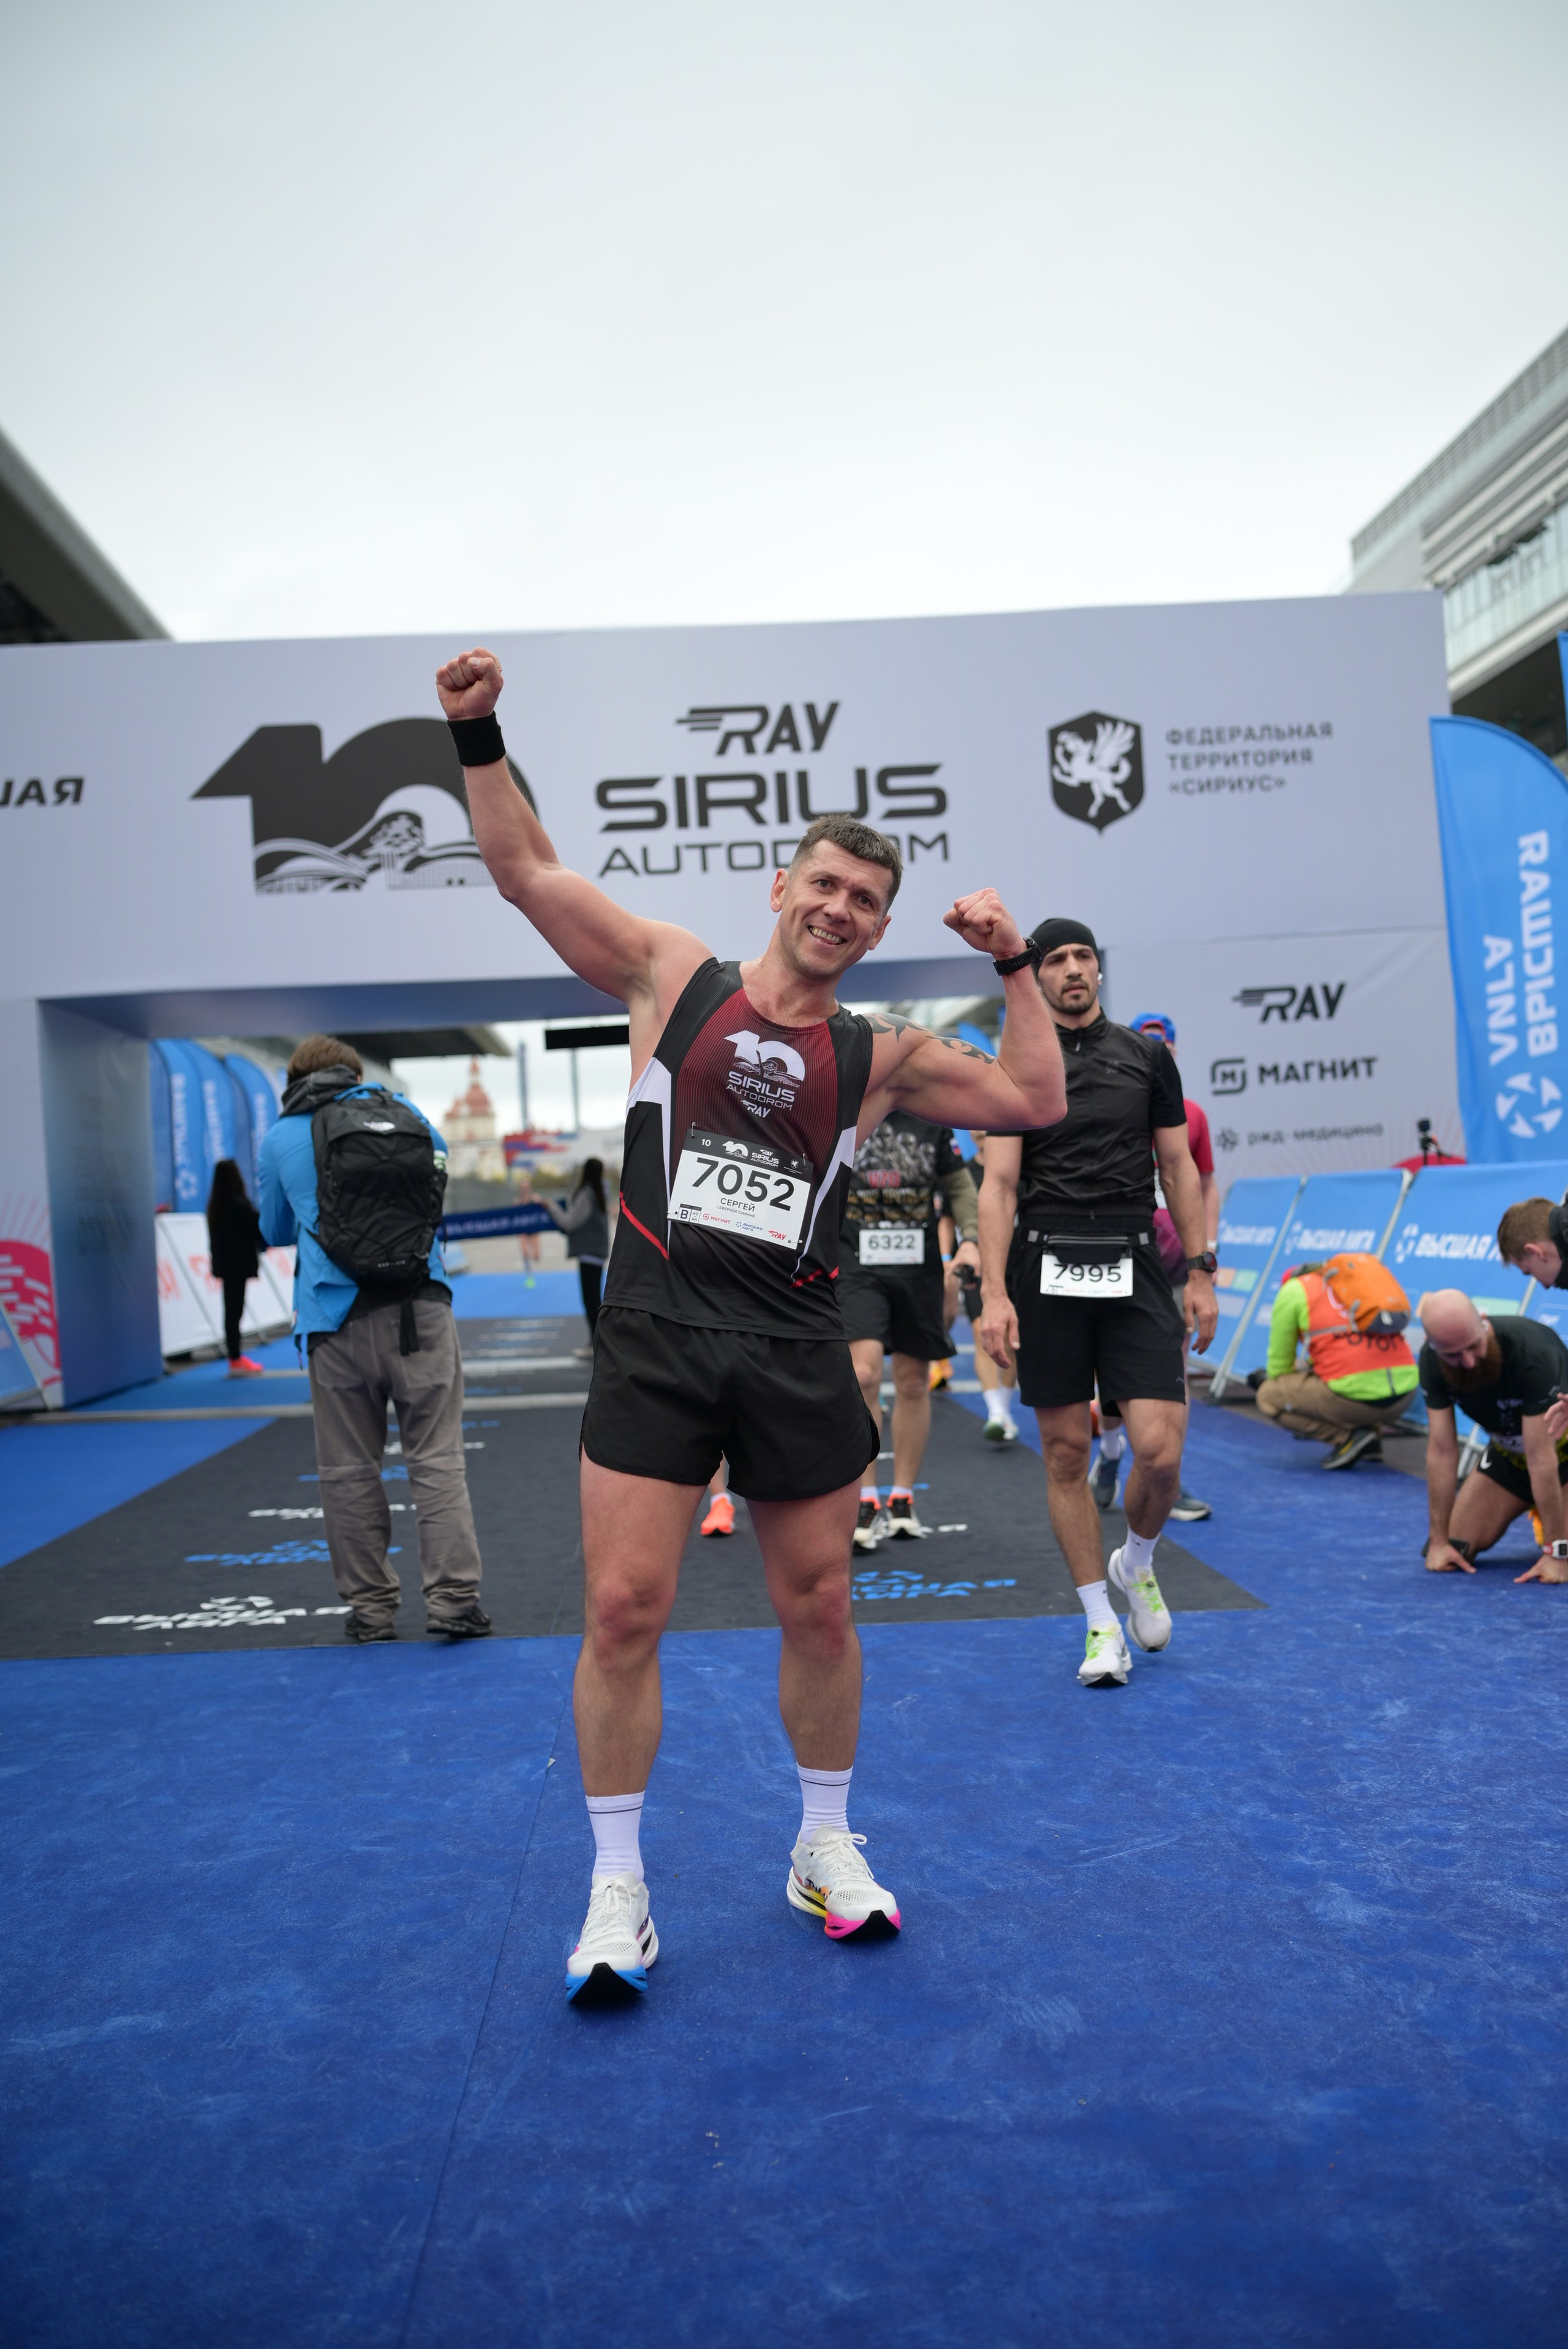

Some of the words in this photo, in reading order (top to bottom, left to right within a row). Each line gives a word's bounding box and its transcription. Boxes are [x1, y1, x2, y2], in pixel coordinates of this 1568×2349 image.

[675, 700, 842, 757] RAY
[1166, 722, 1333, 747] ФЕДЕРАЛЬНАЯ
[1168, 747, 1313, 770] ТЕРРИТОРИЯ
[1169, 774, 1286, 796] «СИРИУС»
[595, 763, 949, 833] SIRIUS
[598, 831, 950, 879] AUTODM
[1257, 1056, 1378, 1084] МАГНИТ
[726, 1084, 793, 1111] AUTODROM
[728, 1070, 796, 1103] SIRIUS
[741, 1099, 771, 1118] RAY
[701, 1138, 711, 1147] 10
[750, 1157, 778, 1168] AUTODROM
[752, 1152, 780, 1164] SIRIUS
[692, 1157, 795, 1212] 7052
[716, 1205, 737, 1214] СЕВЕРНОЕ
[720, 1198, 755, 1212] СЕРГЕЙ
[868, 1233, 916, 1250] 6322
[1054, 1263, 1122, 1282] 7995
